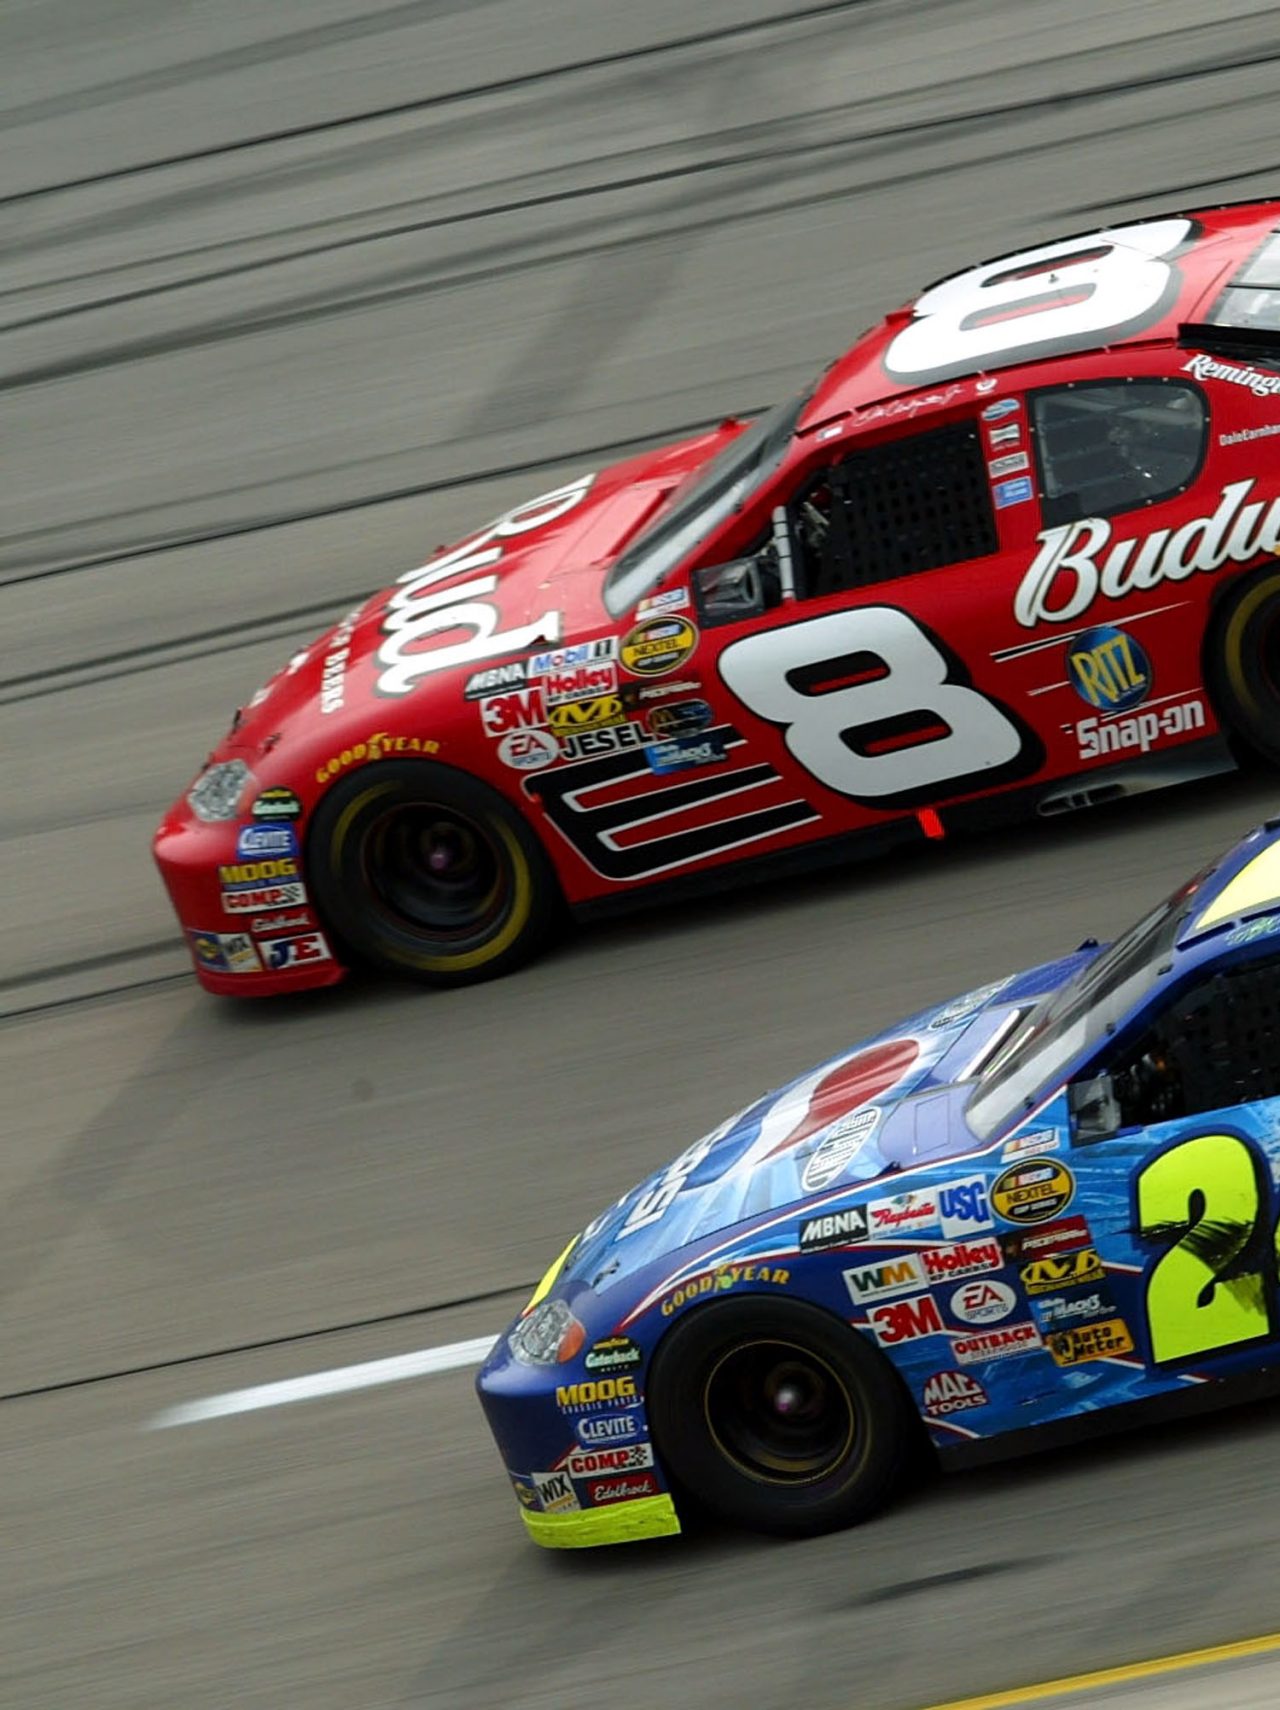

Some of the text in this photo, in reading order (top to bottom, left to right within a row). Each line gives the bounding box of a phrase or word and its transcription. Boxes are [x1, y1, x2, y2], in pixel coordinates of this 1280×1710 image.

[884, 218, 1194, 374] 8
[534, 644, 588, 671] Mobil
[633, 638, 680, 657] NEXTEL
[468, 663, 525, 692] MBNA
[547, 668, 615, 694] Holley
[1070, 632, 1147, 705] RITZ
[485, 689, 546, 735] 3M
[718, 606, 1022, 797] 8
[510, 731, 545, 755] EA
[563, 723, 655, 758] JESEL
[1076, 700, 1205, 760] Snap-on
[316, 732, 440, 783] GOODYEAR
[220, 858, 296, 884] MOOG
[939, 1173, 990, 1224] USG
[1006, 1183, 1057, 1204] NEXTEL
[801, 1209, 867, 1243] MBNA
[922, 1243, 1000, 1276] Holley
[661, 1262, 790, 1317] GOODYEAR
[850, 1261, 918, 1293] WM
[963, 1284, 1004, 1310] EA
[965, 1303, 1009, 1321] SPORTS
[873, 1296, 943, 1343] 3M
[954, 1325, 1036, 1355] OUTBACK
[1073, 1327, 1112, 1344] Auto
[1073, 1336, 1125, 1356] Meter
[556, 1376, 637, 1407] MOOG
[924, 1372, 983, 1405] MAC
[927, 1395, 988, 1416] TOOLS
[578, 1416, 636, 1439] CLEVITE
[570, 1451, 631, 1473] COMP
[538, 1473, 571, 1503] WIX
